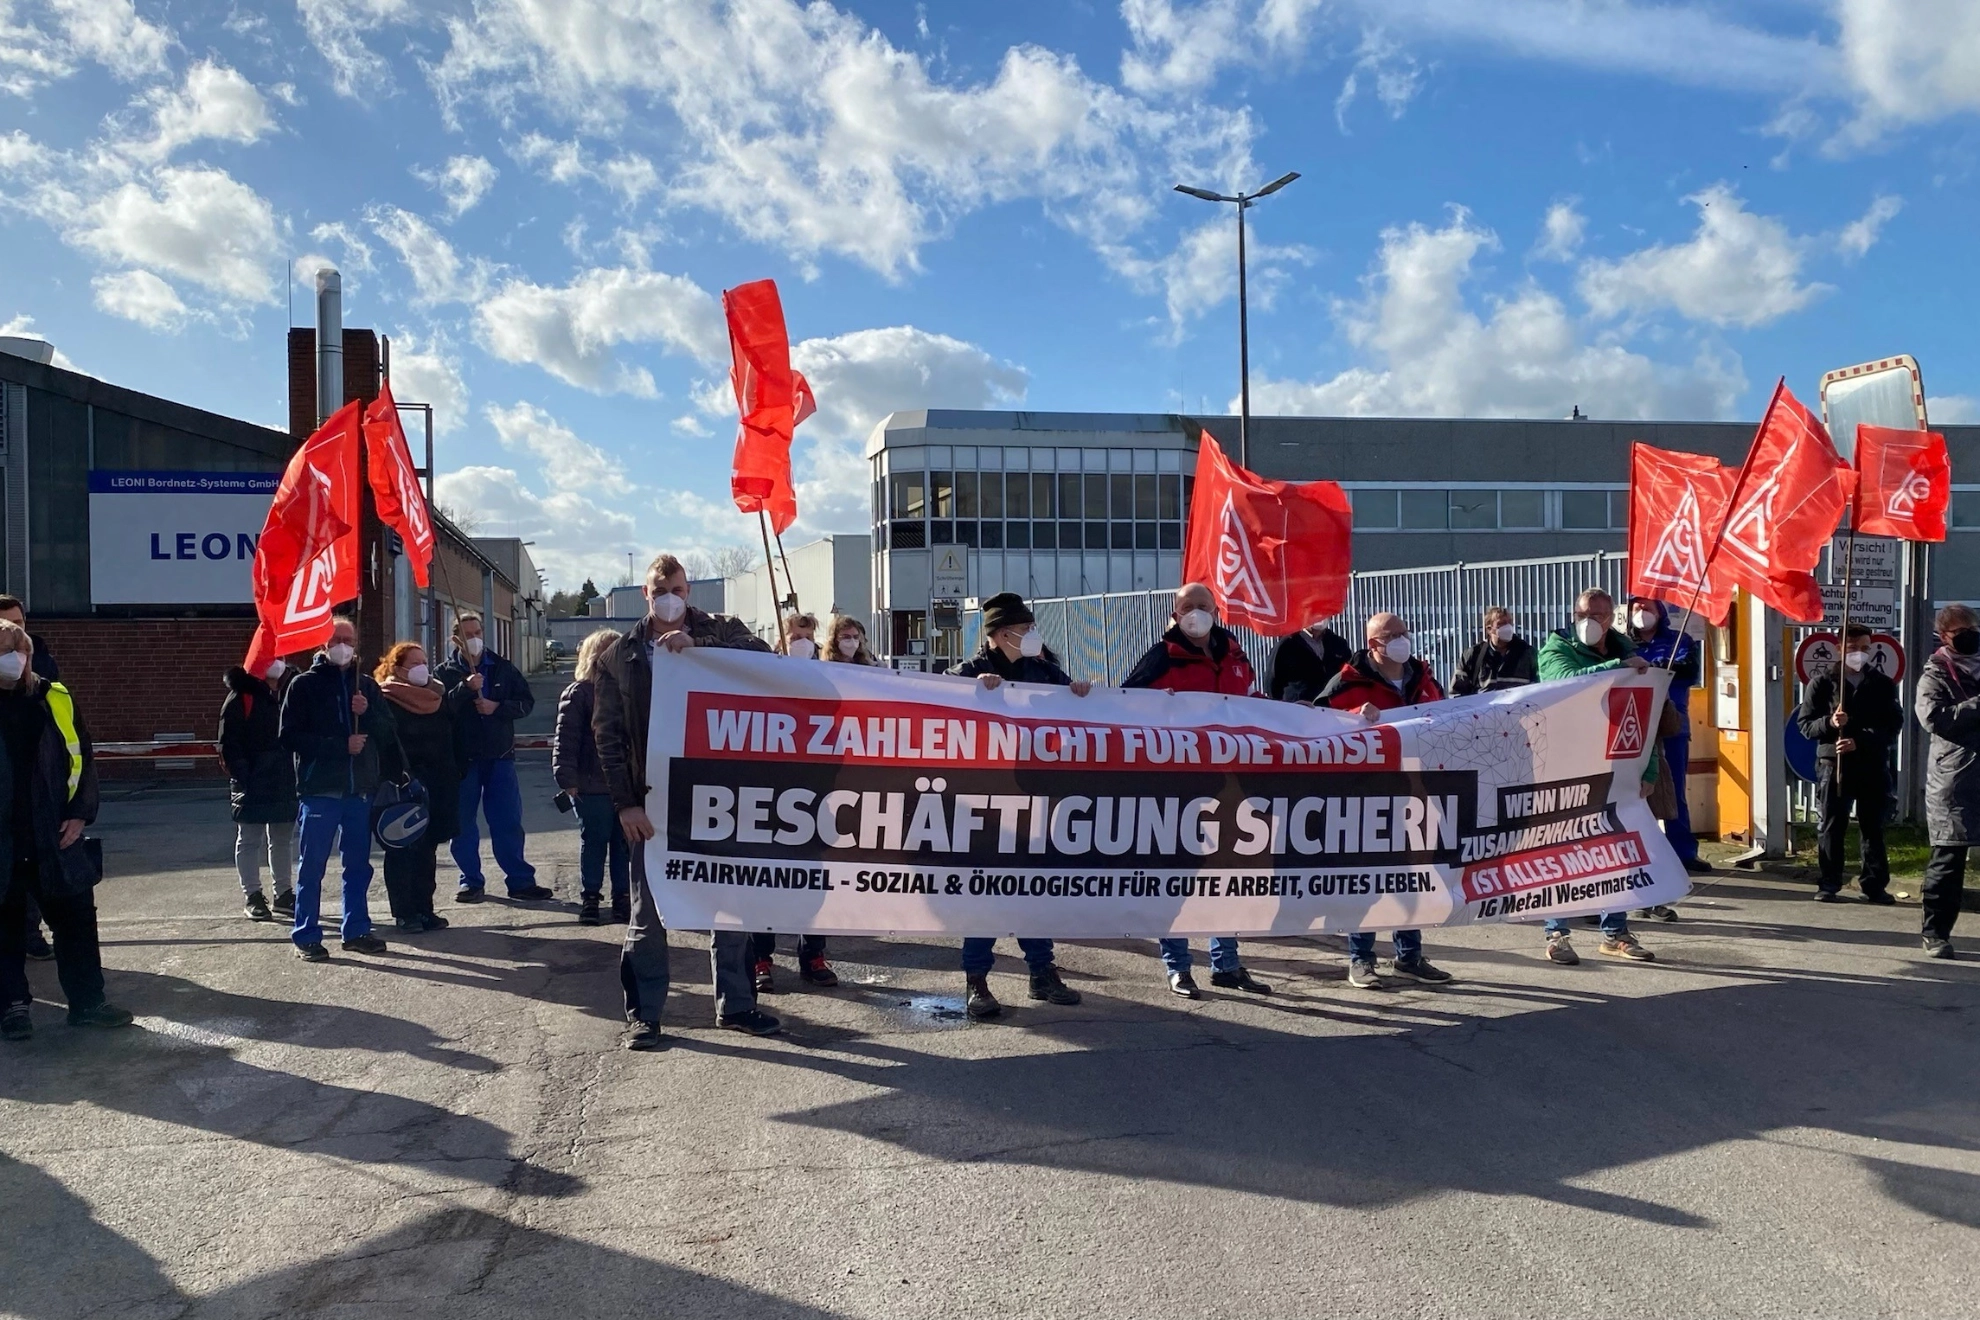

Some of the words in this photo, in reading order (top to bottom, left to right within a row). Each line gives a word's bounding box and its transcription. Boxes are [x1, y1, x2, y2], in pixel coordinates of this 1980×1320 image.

[111, 477, 145, 487] LEONI
[148, 478, 246, 490] Bordnetz-Systeme
[247, 479, 280, 489] GmbH
[150, 532, 260, 561] LEON
[1838, 540, 1886, 554] Vrsicht
[1855, 555, 1871, 565] wird
[1872, 557, 1885, 566] nur
[1835, 565, 1865, 576] teileise
[1865, 567, 1893, 579] gestreut
[1822, 601, 1892, 614] ranknöffnung
[706, 709, 797, 754] WIR
[806, 715, 977, 760] ZAHLEN
[987, 720, 1112, 763] NICHT
[1120, 727, 1202, 764] FÜR
[1206, 730, 1273, 765] DIE
[690, 776, 1220, 856] BESCHÄFTIGUNG
[1232, 795, 1459, 855] SICHERN
[1505, 788, 1556, 819] WENN
[1559, 783, 1592, 810] WIR
[1460, 811, 1616, 863] ZUSAMMENHALTEN
[665, 858, 835, 891] #FAIRWANDEL
[855, 870, 939, 895] SOZIAL
[944, 874, 963, 895] &
[968, 869, 1113, 897] ÖKOLOGISCH
[1117, 870, 1161, 897] FÜR
[1165, 876, 1221, 897] GUTE
[1224, 875, 1304, 899] ARBEIT,
[1308, 873, 1371, 895] GUTES
[1374, 871, 1437, 894] LEBEN.
[1470, 867, 1507, 895] IST
[1503, 856, 1563, 888] ALLES
[1562, 839, 1642, 876] MÖGLICH
[1477, 900, 1500, 919] IG
[1499, 887, 1553, 914] Metall
[1555, 868, 1655, 903] Wesermarsch
